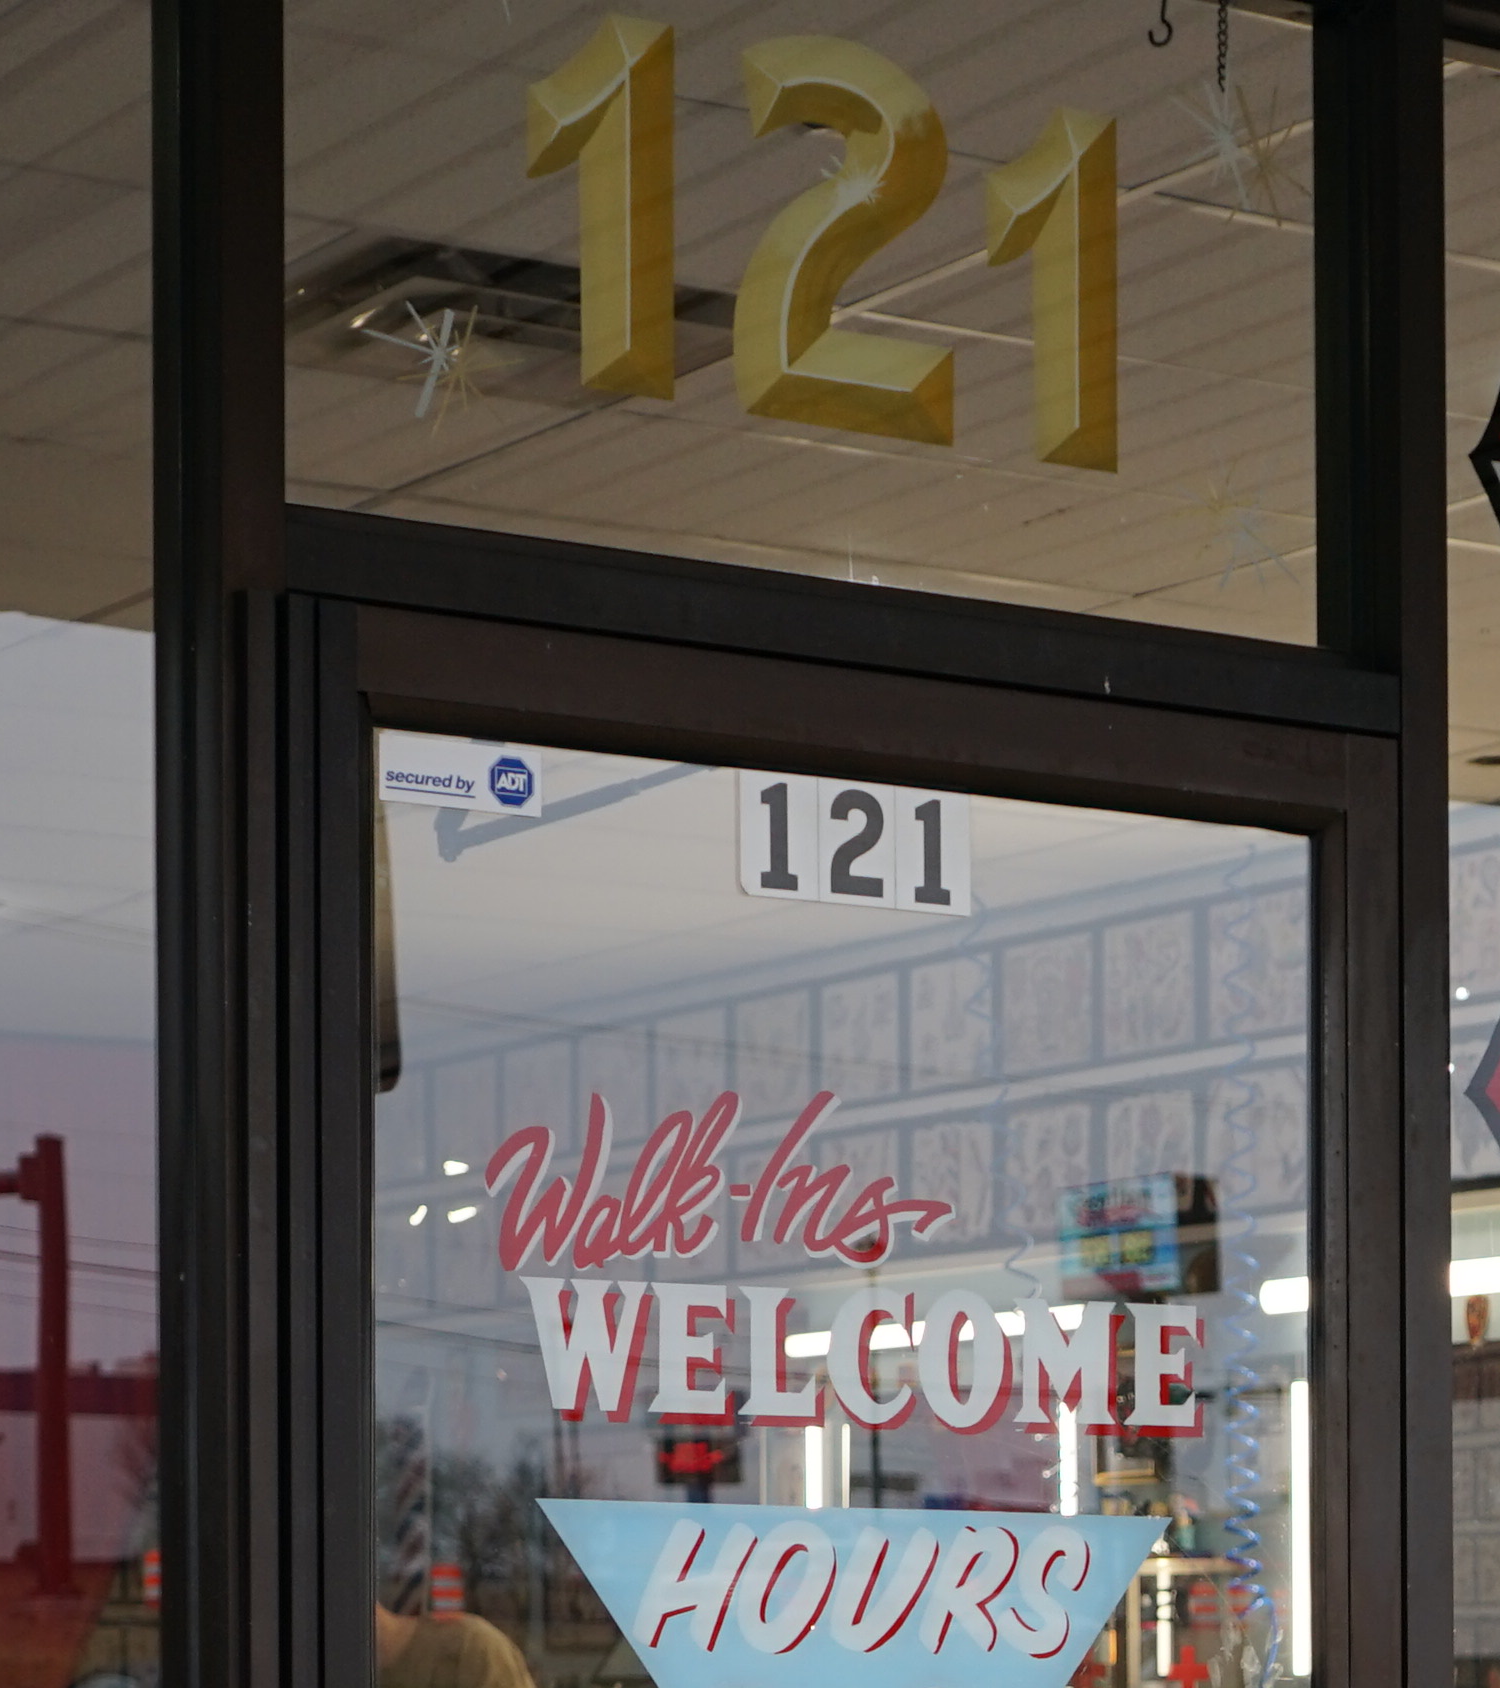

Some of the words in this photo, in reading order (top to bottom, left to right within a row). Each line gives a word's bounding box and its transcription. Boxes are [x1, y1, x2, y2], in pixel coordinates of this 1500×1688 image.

[526, 13, 1120, 475] 121
[384, 768, 454, 795] secured
[454, 774, 476, 799] by
[496, 771, 527, 793] ADT
[759, 780, 954, 907] 121
[484, 1089, 956, 1275] Walk-Ins
[519, 1275, 1207, 1439] WELCOME
[632, 1517, 1092, 1659] HOURS
